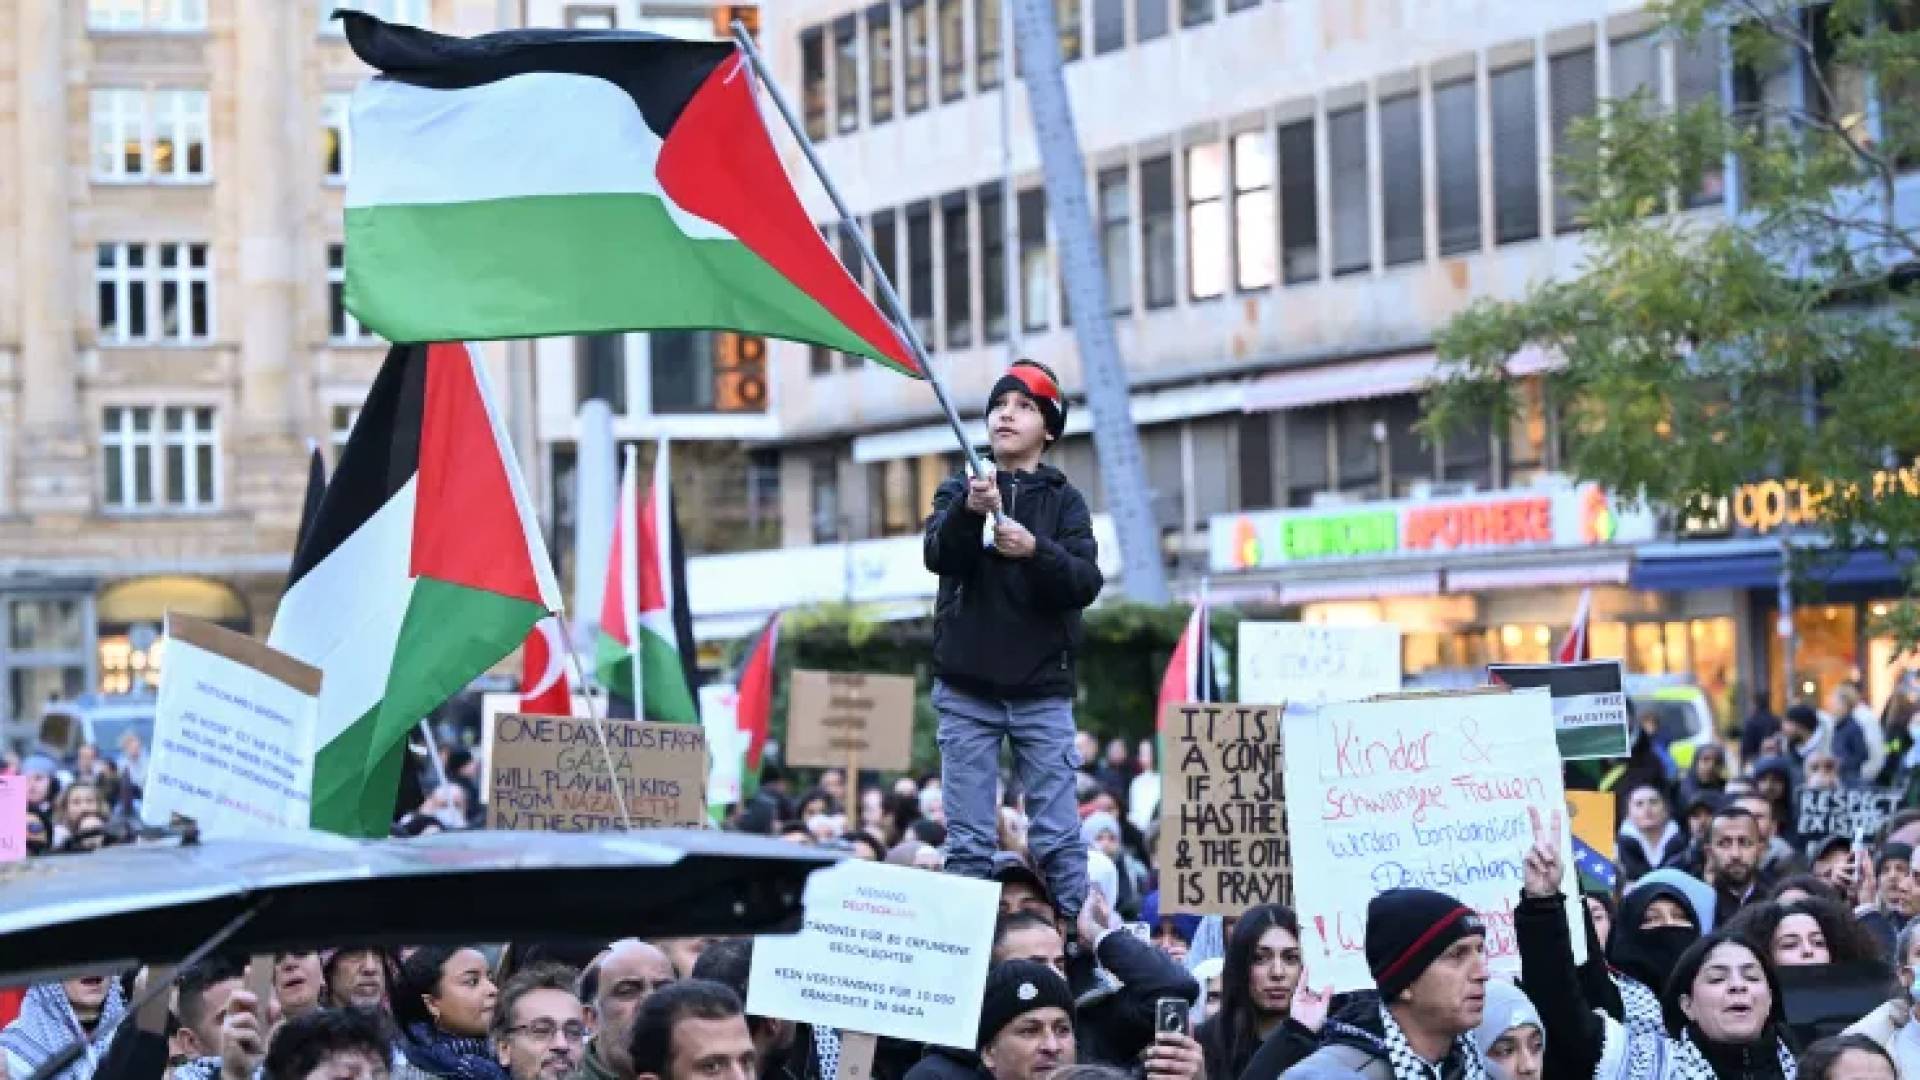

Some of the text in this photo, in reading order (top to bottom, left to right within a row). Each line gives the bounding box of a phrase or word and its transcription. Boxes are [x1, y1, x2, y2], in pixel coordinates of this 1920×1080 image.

[499, 716, 705, 750] ONE DAY KIDS FROM
[1180, 708, 1221, 742] IT
[1236, 709, 1268, 743] IS
[557, 748, 632, 773] GAZA
[1181, 743, 1209, 773] A
[1331, 718, 1433, 778] Kinder
[1459, 715, 1491, 763] &
[496, 768, 680, 798] WILL PLAY WITH KIDS
[1187, 775, 1211, 801] IF
[1229, 773, 1247, 800] 1
[1450, 775, 1546, 802] Frauen
[495, 791, 680, 815] FROM NAZAETH
[496, 812, 519, 831] IN
[523, 813, 566, 832] THE
[1181, 803, 1234, 836] HAS
[1236, 804, 1276, 834] THE
[1174, 840, 1193, 869] &
[1199, 840, 1243, 867] THE
[1326, 829, 1401, 858] werden
[1178, 872, 1205, 906] IS
[861, 928, 883, 944] FÜR
[889, 985, 912, 999] FÜR
[873, 998, 888, 1012] IN
[891, 1001, 925, 1018] GAZA
